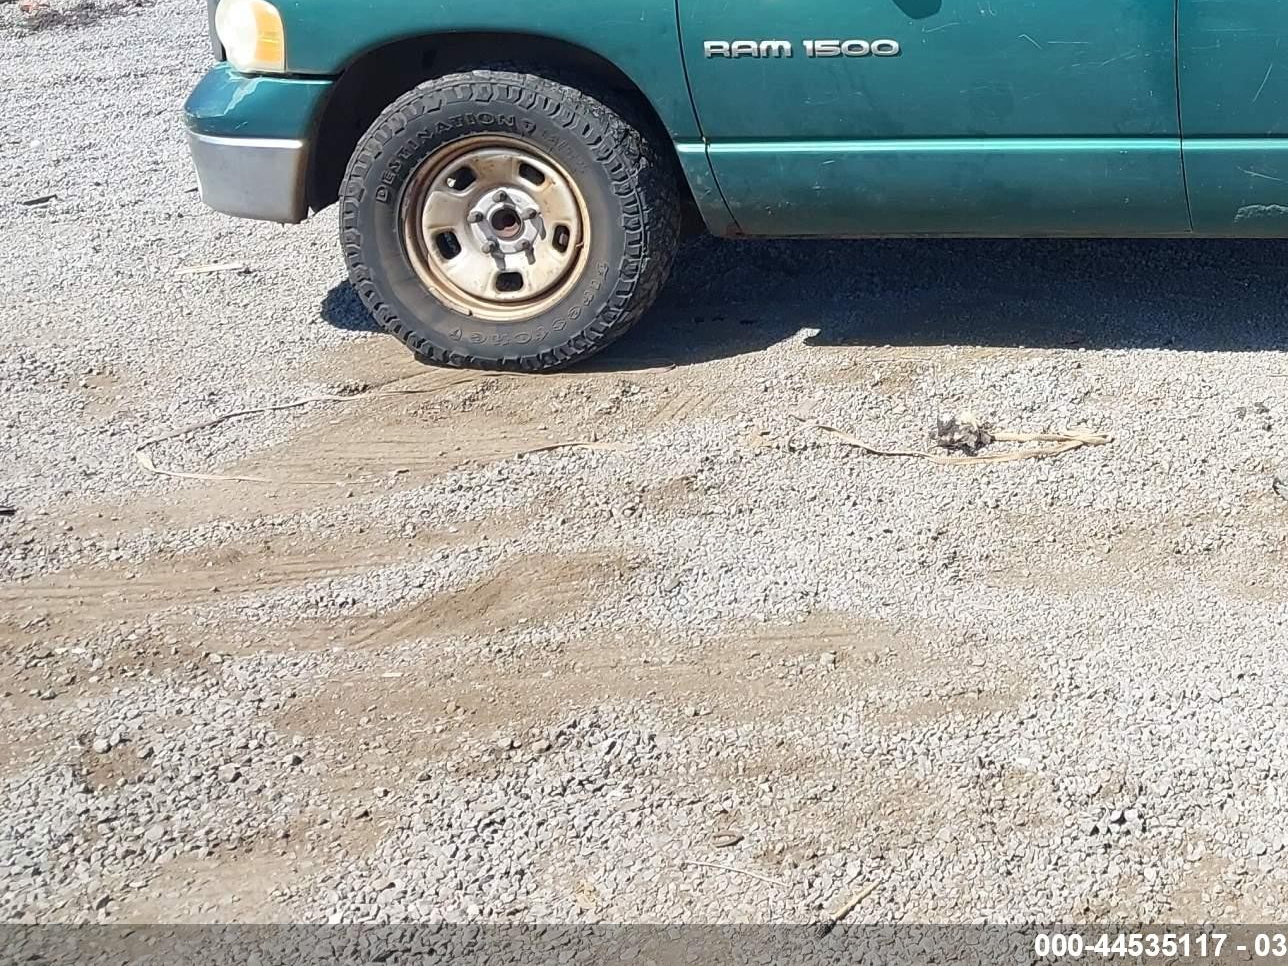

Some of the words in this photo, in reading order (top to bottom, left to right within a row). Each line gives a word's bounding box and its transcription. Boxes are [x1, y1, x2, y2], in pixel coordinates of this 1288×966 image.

[703, 39, 793, 58] RAM
[802, 39, 901, 58] 1500
[375, 112, 517, 204] DESTINATION
